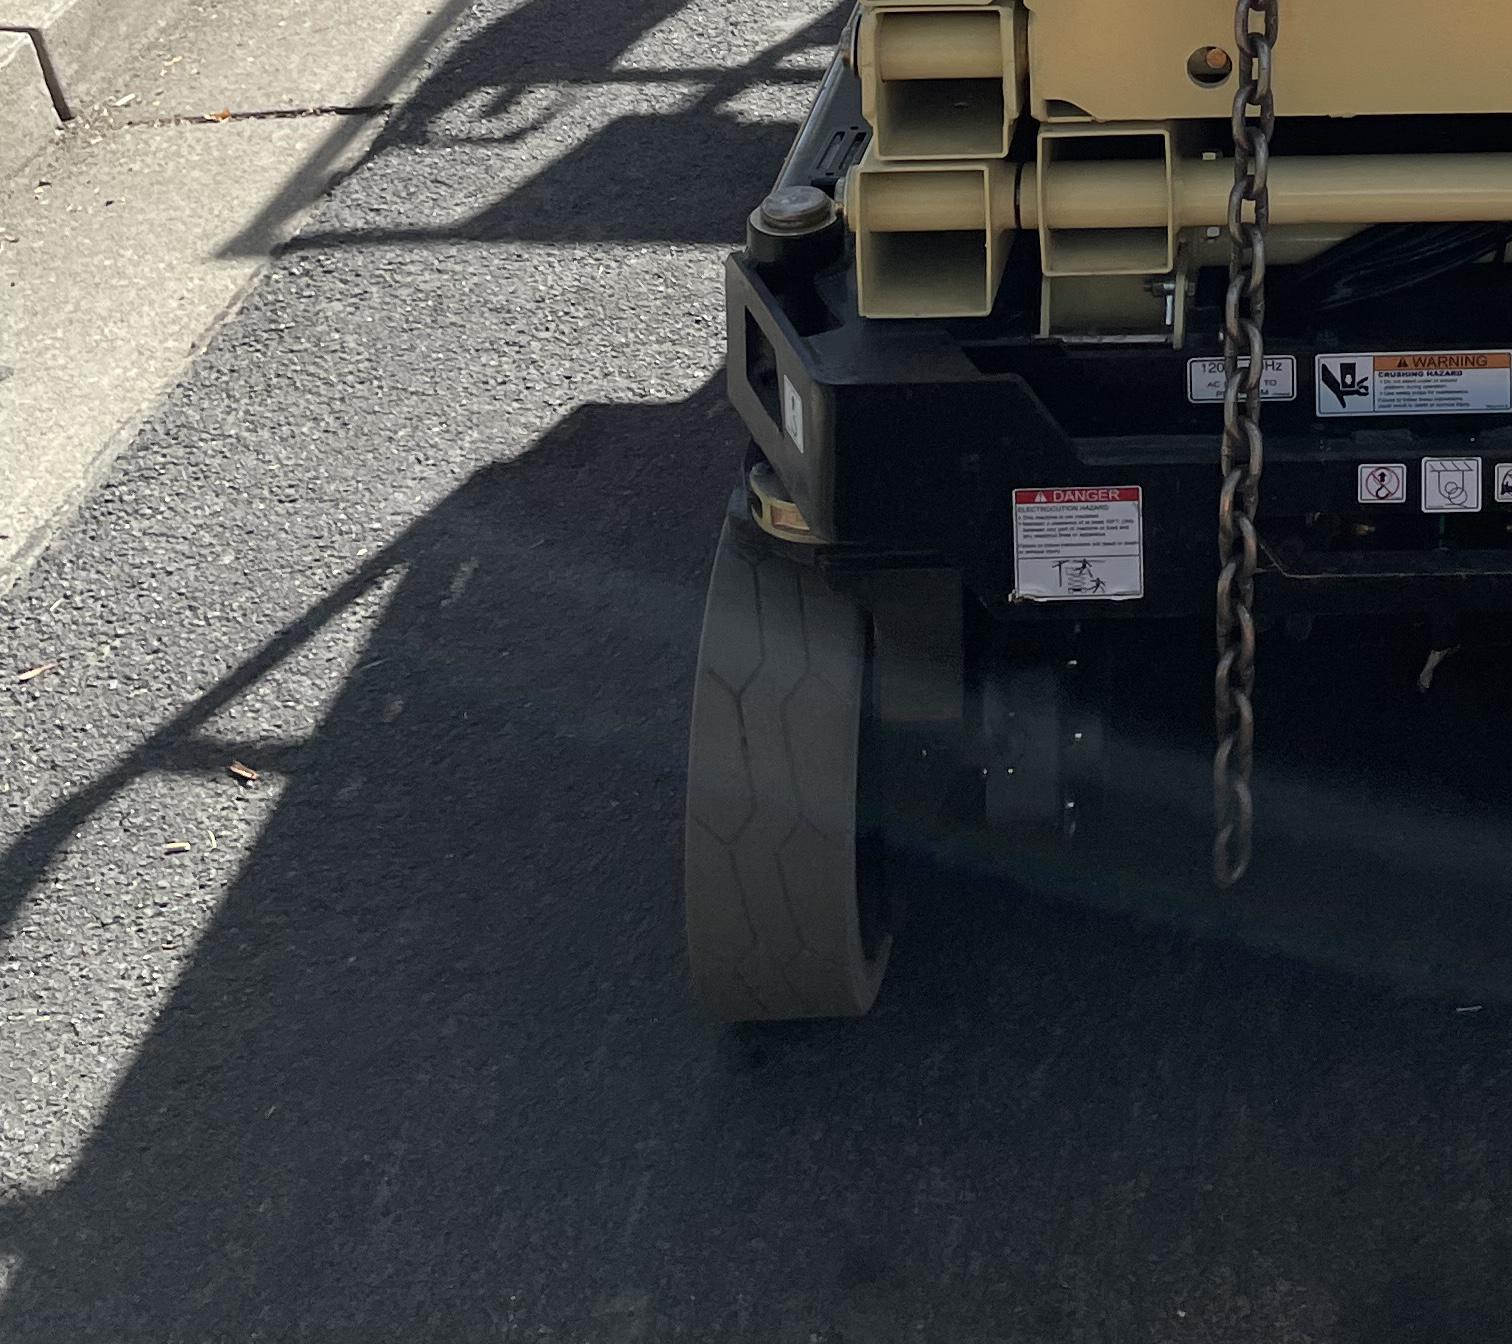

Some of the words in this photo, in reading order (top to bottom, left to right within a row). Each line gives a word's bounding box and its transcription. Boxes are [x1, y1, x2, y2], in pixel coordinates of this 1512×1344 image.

[1414, 354, 1488, 368] WARNING
[1426, 369, 1463, 378] HAZARD
[1053, 489, 1121, 502] DANGER
